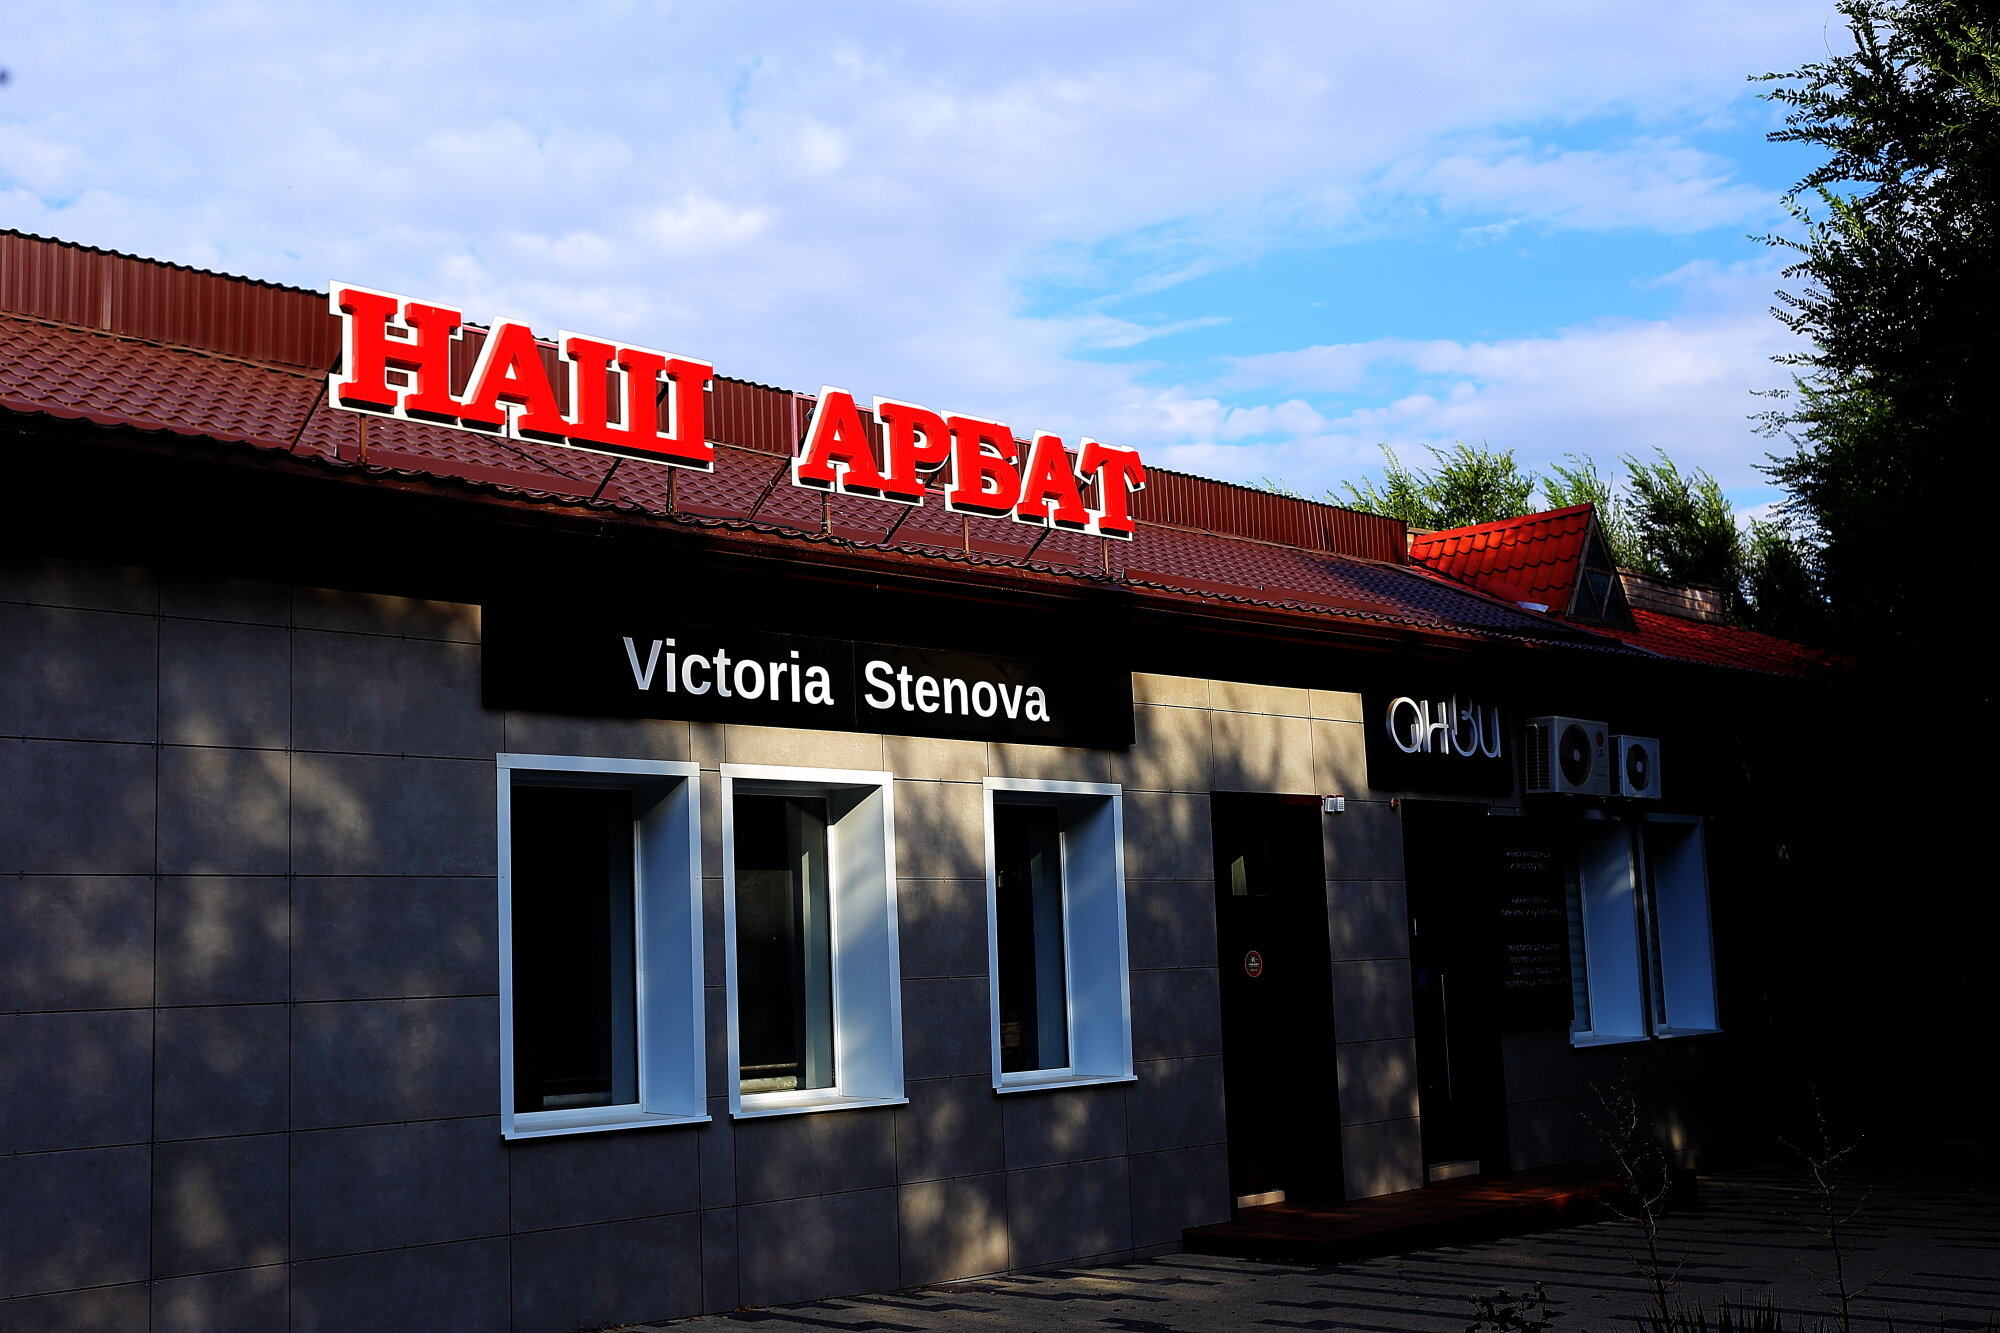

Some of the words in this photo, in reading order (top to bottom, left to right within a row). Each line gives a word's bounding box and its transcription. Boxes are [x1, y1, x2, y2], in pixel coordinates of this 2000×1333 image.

[330, 280, 714, 473] НАШ
[792, 385, 1146, 541] АРБАТ
[622, 637, 835, 706] Victoria
[864, 660, 1051, 723] Stenova
